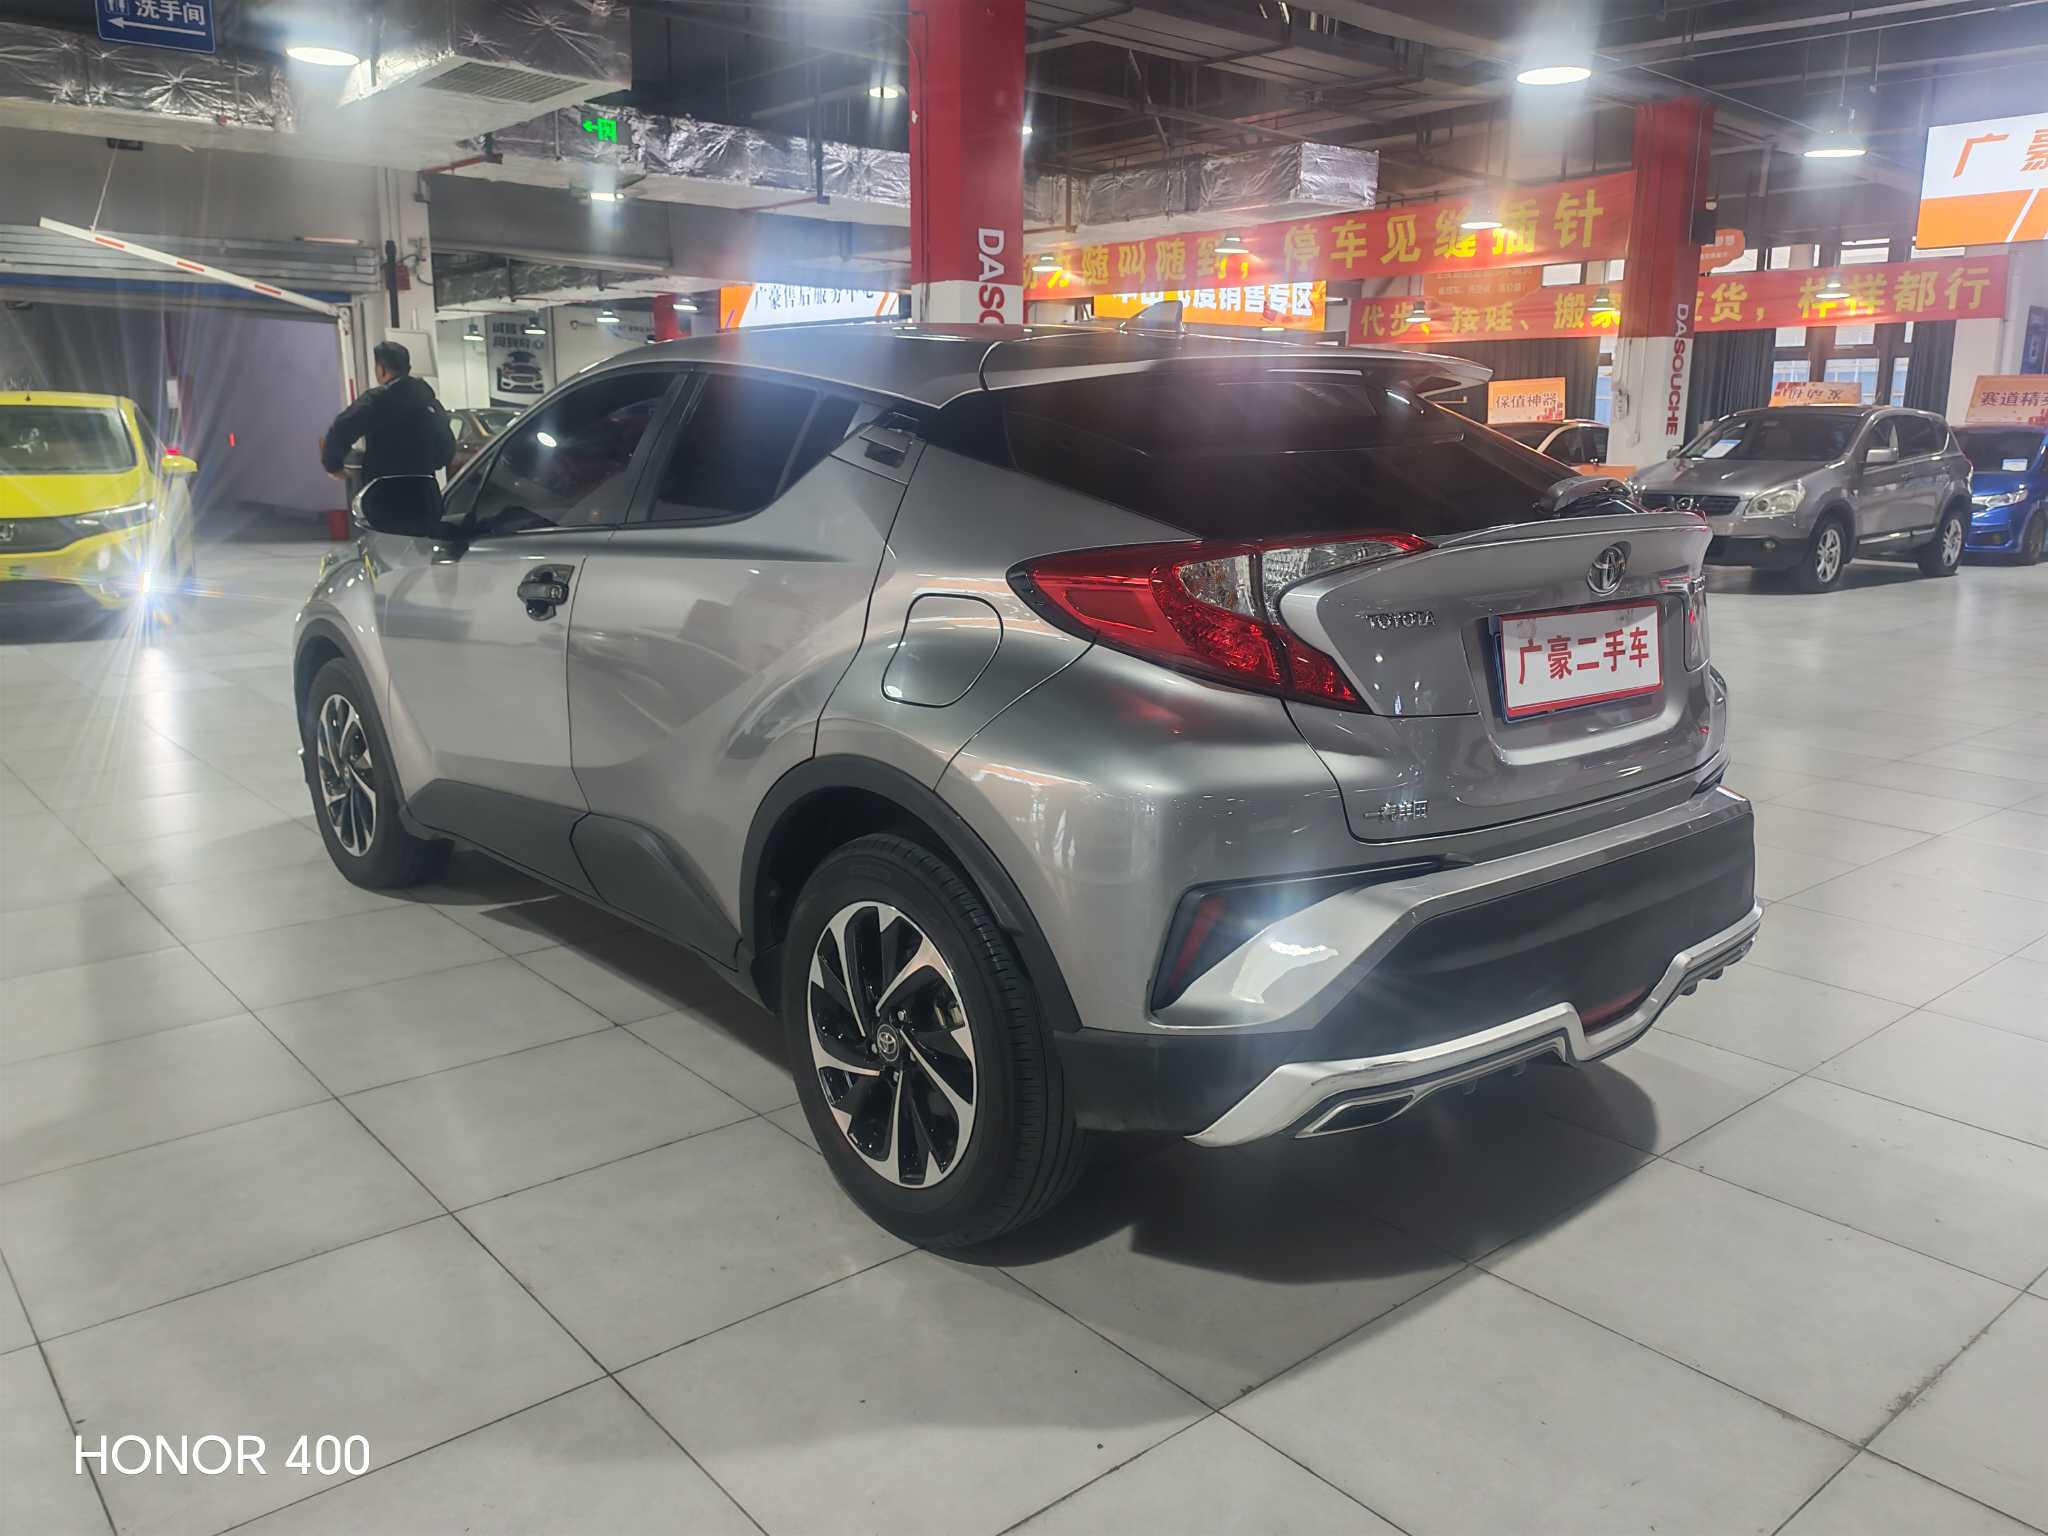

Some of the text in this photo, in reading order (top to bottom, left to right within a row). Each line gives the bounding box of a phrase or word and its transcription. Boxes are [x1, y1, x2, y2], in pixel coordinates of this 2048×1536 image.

[136, 0, 206, 25] 洗手间
[1112, 282, 1313, 316] 度销售专区
[1666, 303, 1689, 436] DASOUCHE
[1366, 611, 1438, 630] TOYOTA
[1518, 626, 1650, 685] 广豪二手车
